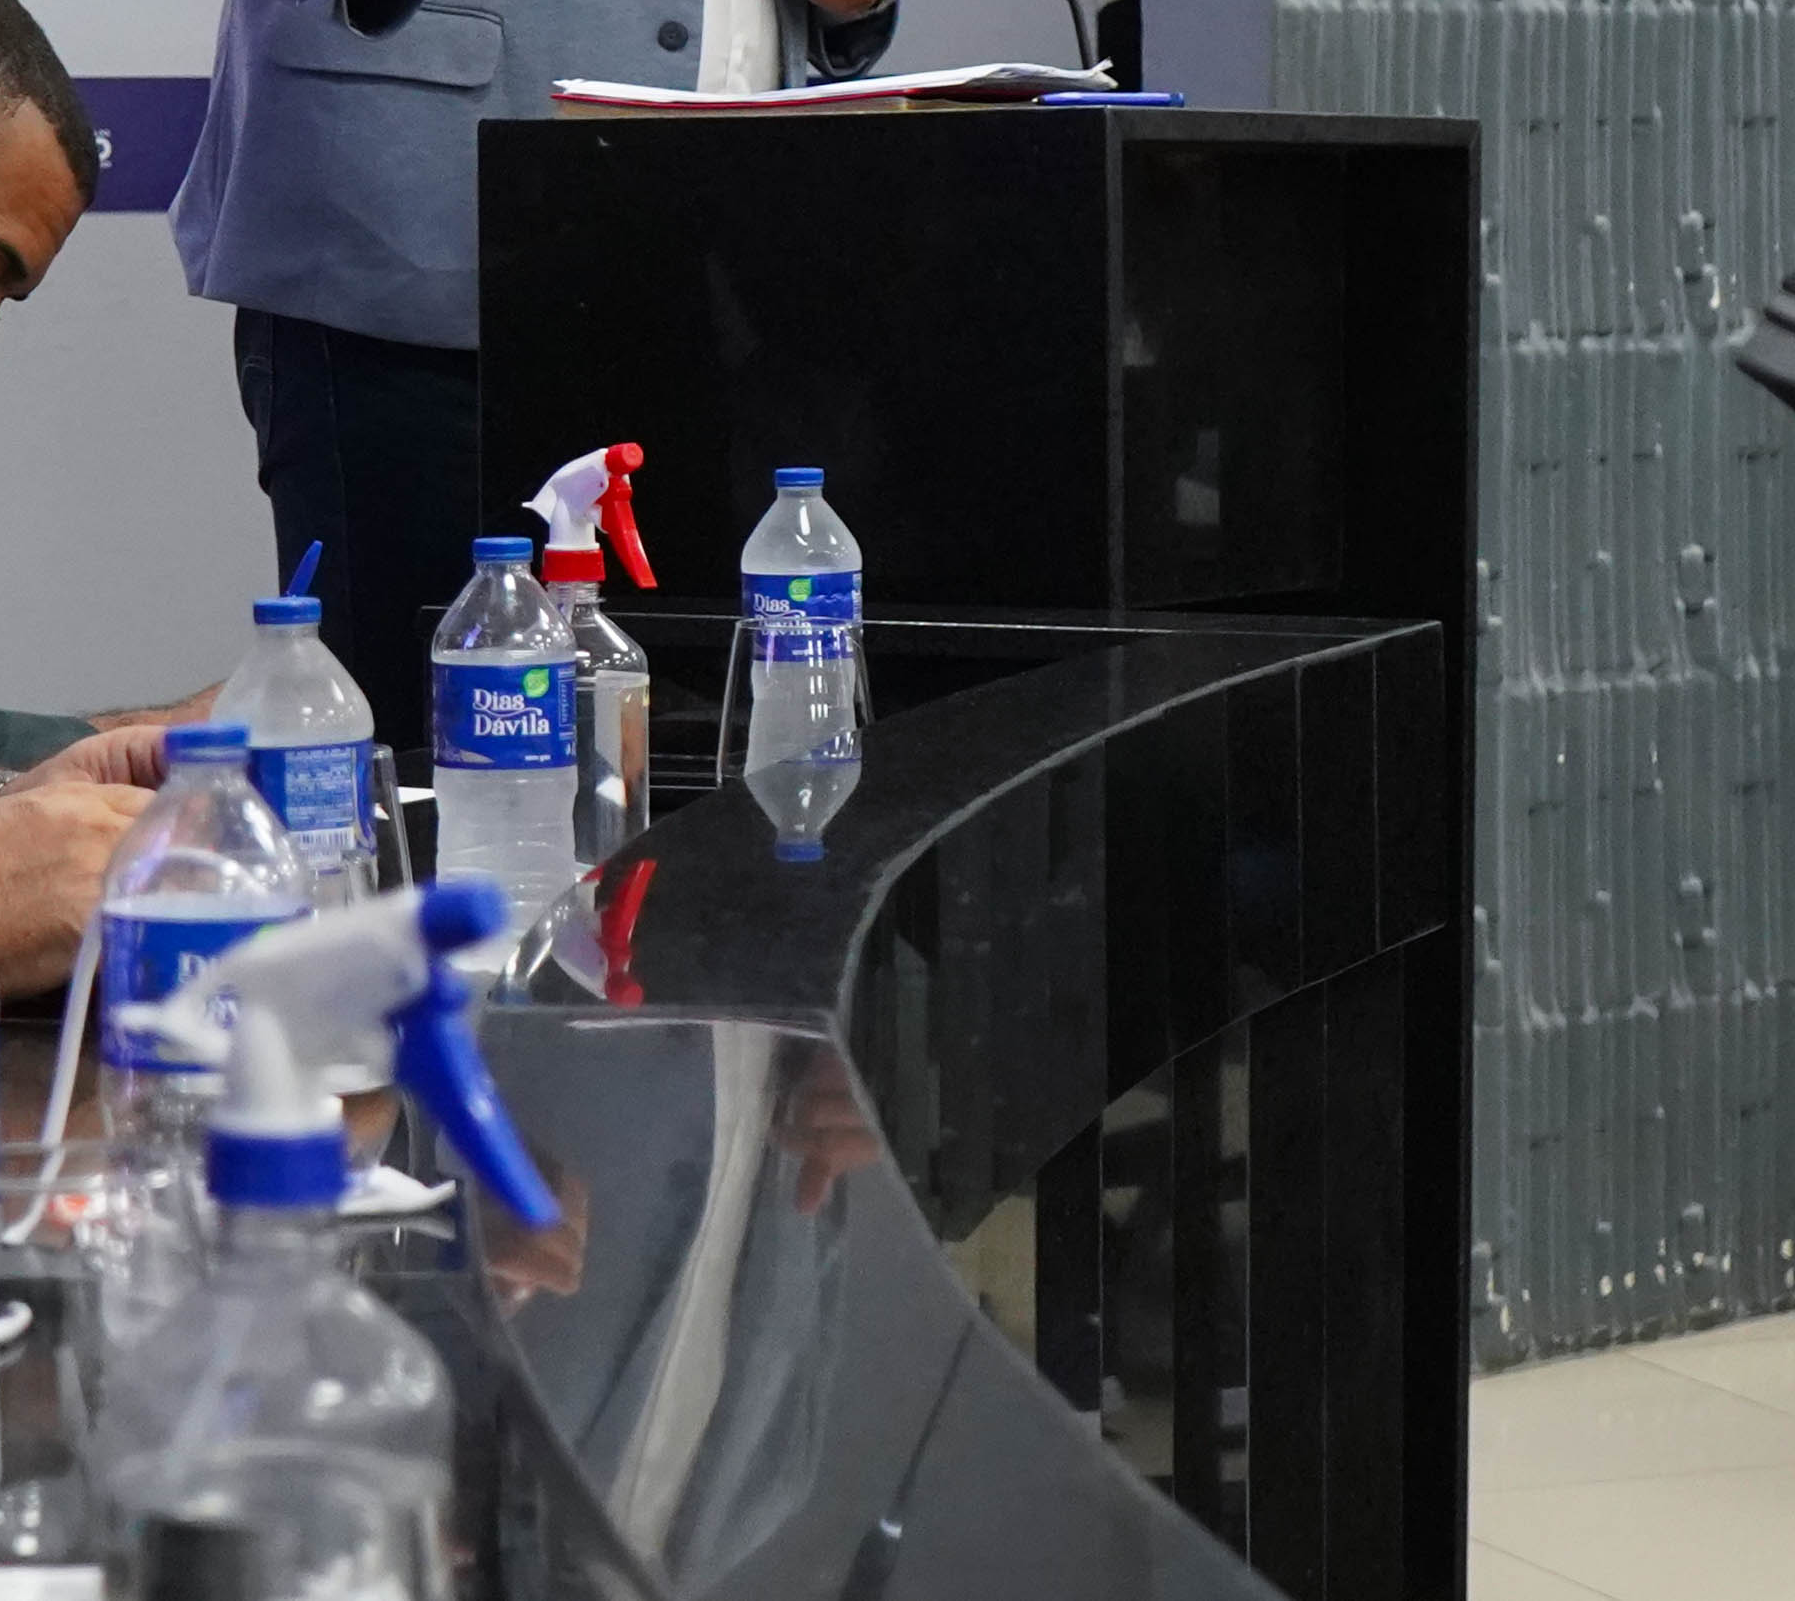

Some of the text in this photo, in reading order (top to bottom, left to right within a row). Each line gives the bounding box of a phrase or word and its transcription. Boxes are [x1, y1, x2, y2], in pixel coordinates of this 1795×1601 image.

[753, 593, 790, 613] Dias
[472, 688, 525, 712] Dias
[474, 713, 551, 736] Dávila
